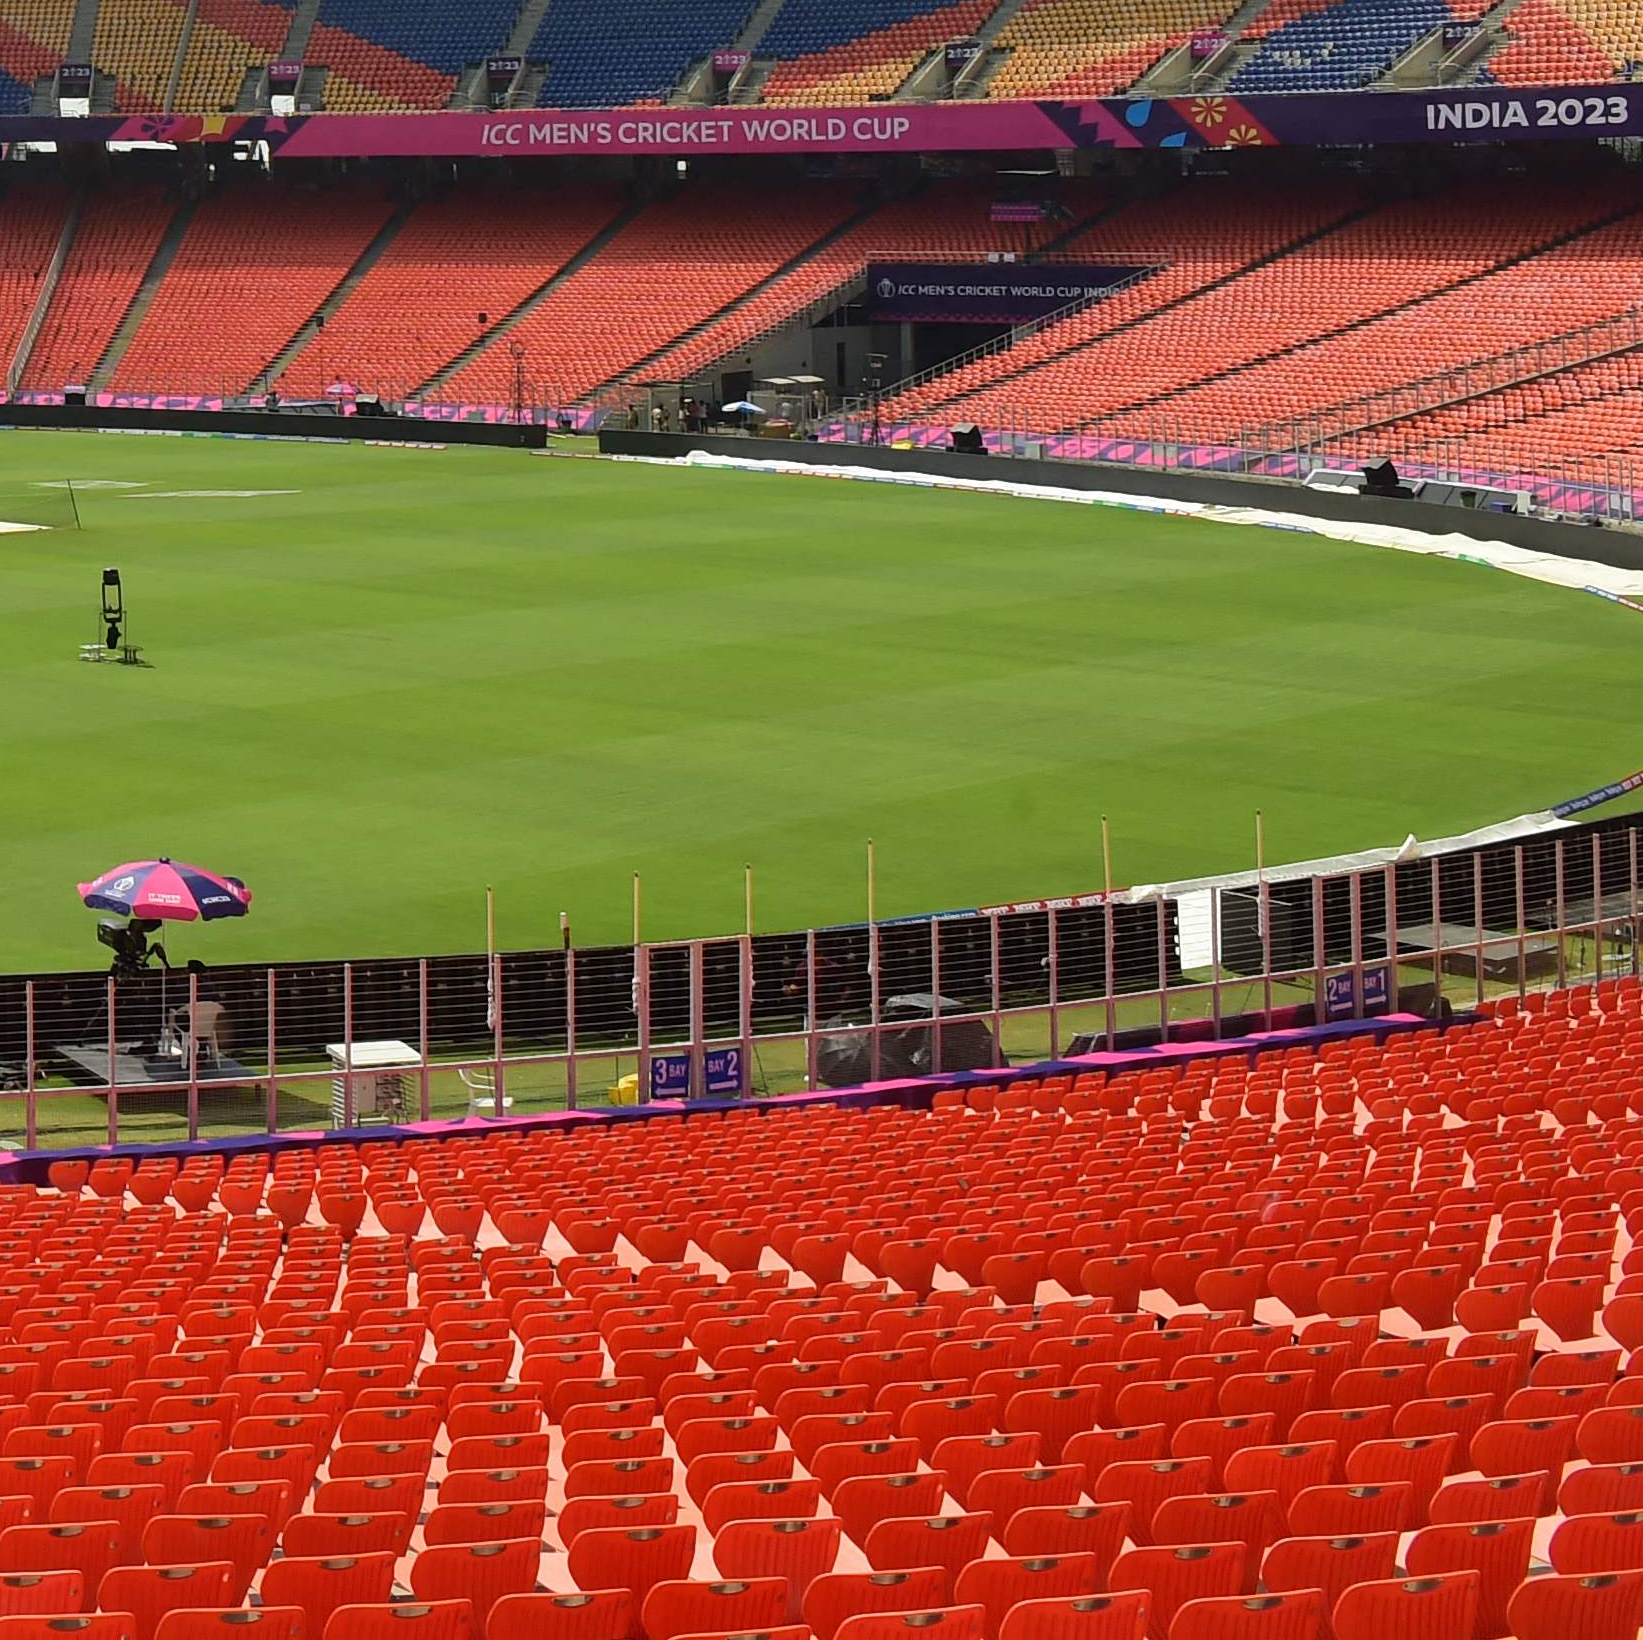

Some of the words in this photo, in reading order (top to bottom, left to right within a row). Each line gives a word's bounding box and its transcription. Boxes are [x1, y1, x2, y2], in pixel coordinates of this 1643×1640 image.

[1426, 101, 1530, 130] INDIA
[1535, 96, 1629, 126] 2023
[482, 123, 521, 146] ICC
[529, 123, 611, 144] MEN'S
[618, 121, 734, 144] CRICKET
[741, 119, 846, 141] WORLD
[853, 117, 909, 140] CUP
[898, 284, 916, 295] ICC
[918, 285, 955, 297] MEN'S
[957, 285, 1007, 297] CRICKET
[1010, 286, 1055, 298] WORLD
[1057, 287, 1081, 298] CUP
[1329, 978, 1338, 1001] 2
[1378, 968, 1385, 991] 1
[655, 1059, 667, 1084] 3
[669, 1064, 686, 1077] BAY
[708, 1059, 725, 1073] BAY
[727, 1051, 738, 1076] 2
